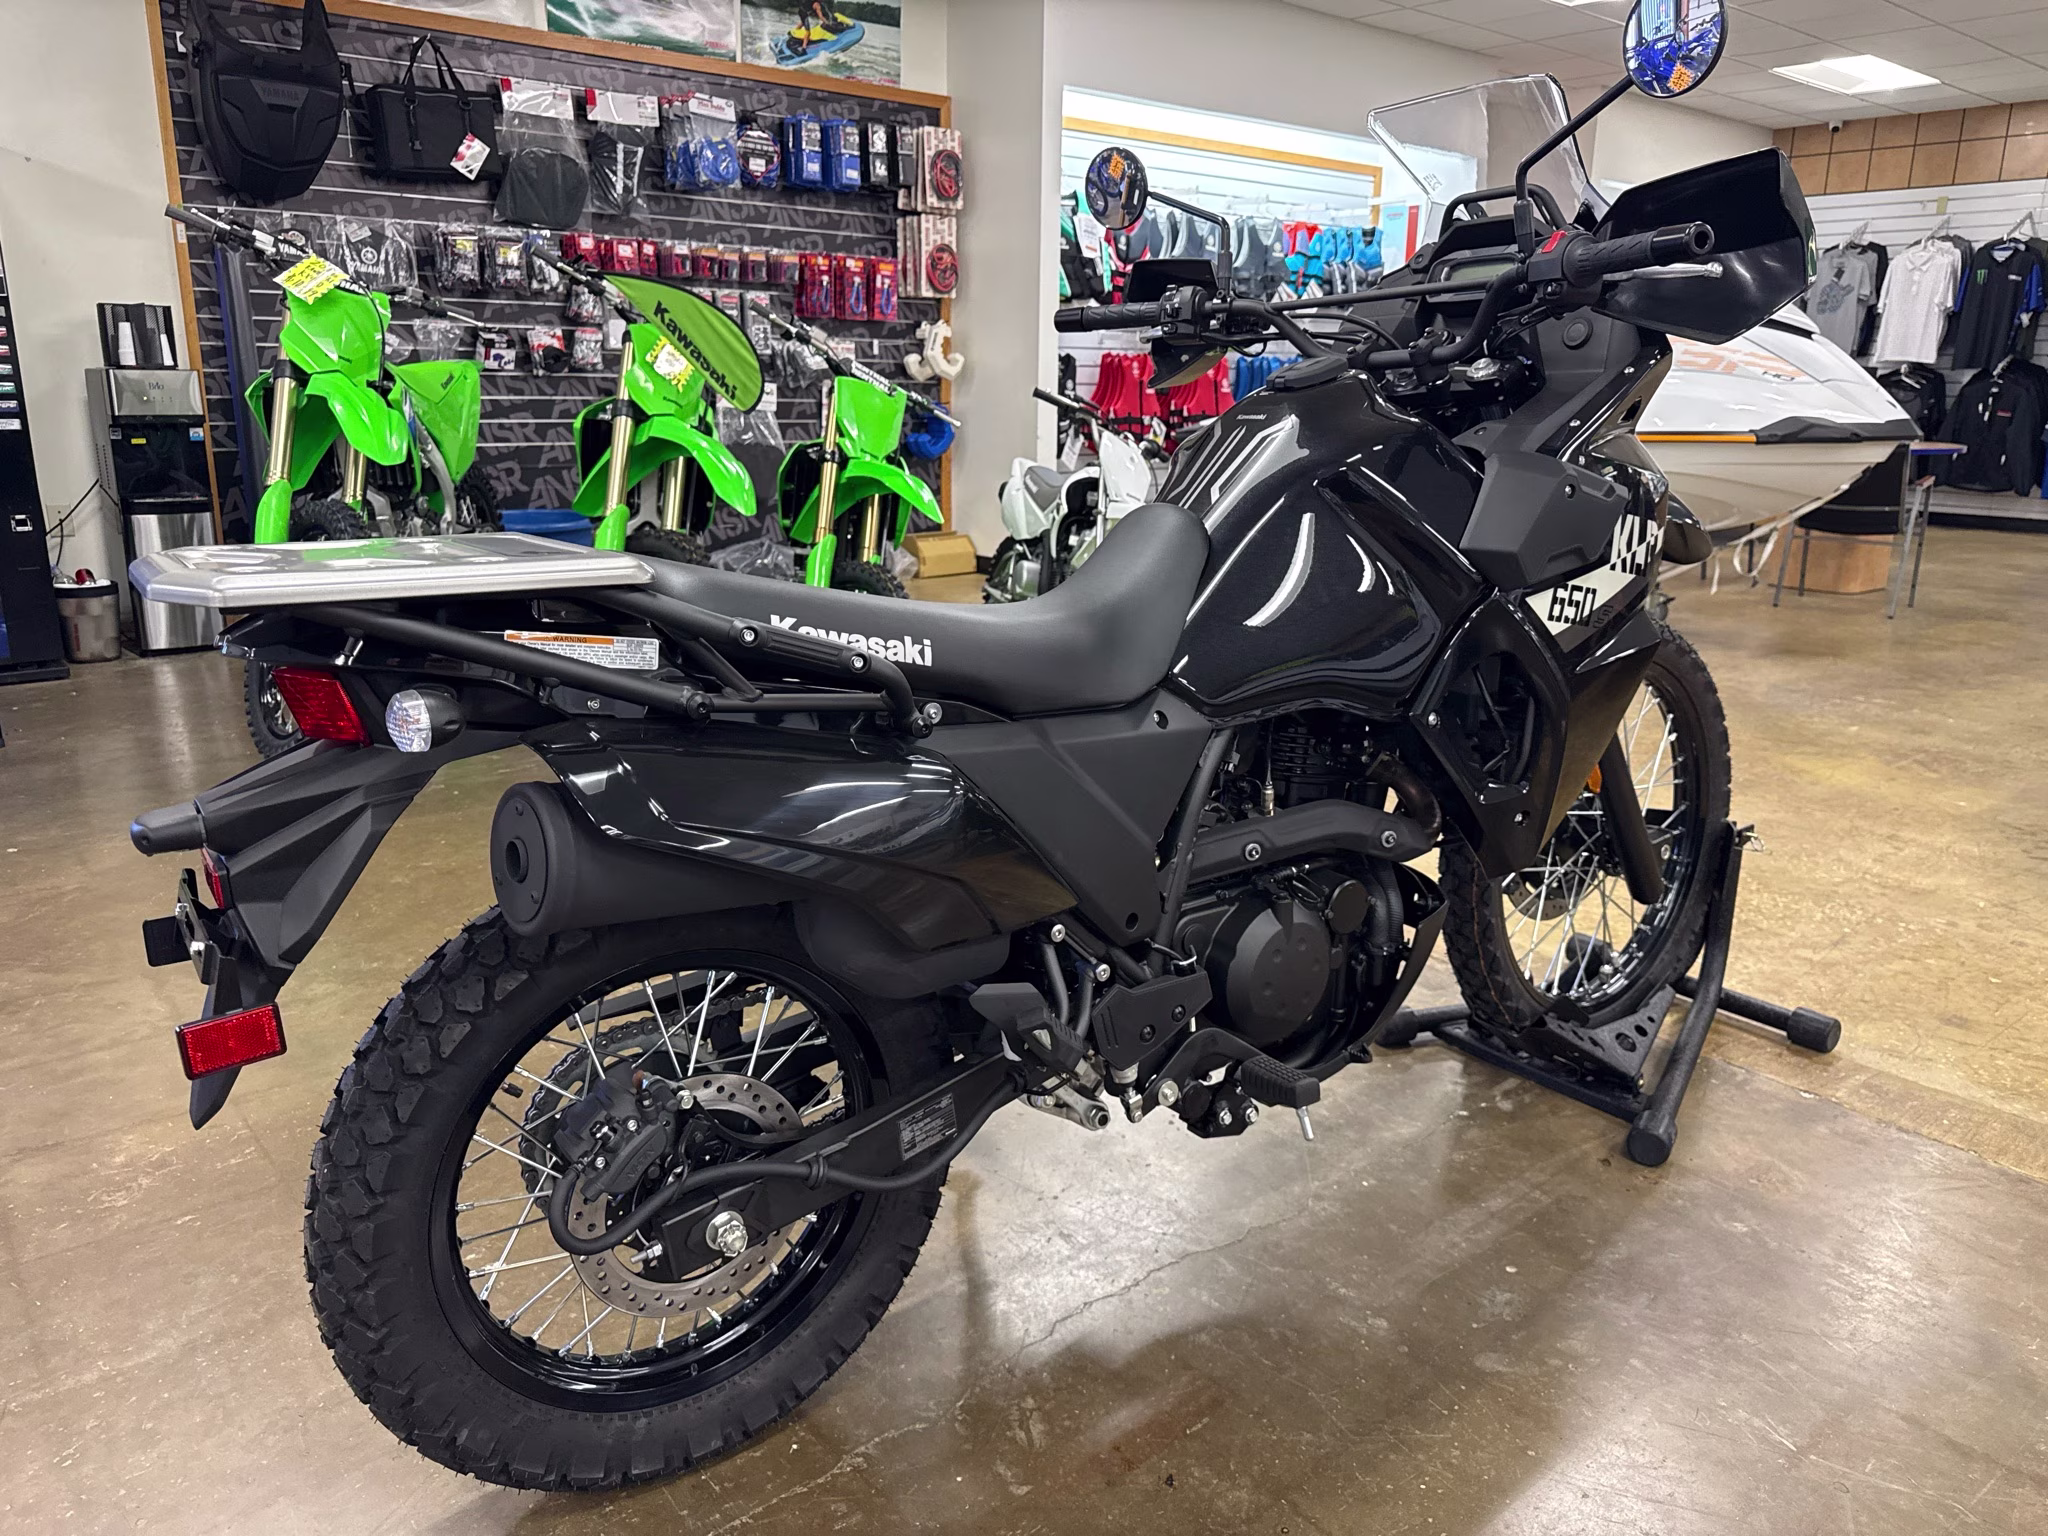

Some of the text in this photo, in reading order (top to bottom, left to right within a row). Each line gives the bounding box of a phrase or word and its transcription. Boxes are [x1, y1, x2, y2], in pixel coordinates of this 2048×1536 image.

[351, 260, 385, 275] YAMAHA
[654, 300, 738, 401] Kawasaki
[481, 374, 556, 414] NSR
[551, 376, 619, 420] ANS
[478, 411, 543, 457] NSR
[1547, 581, 1598, 627] 650
[552, 636, 588, 644] WARNING
